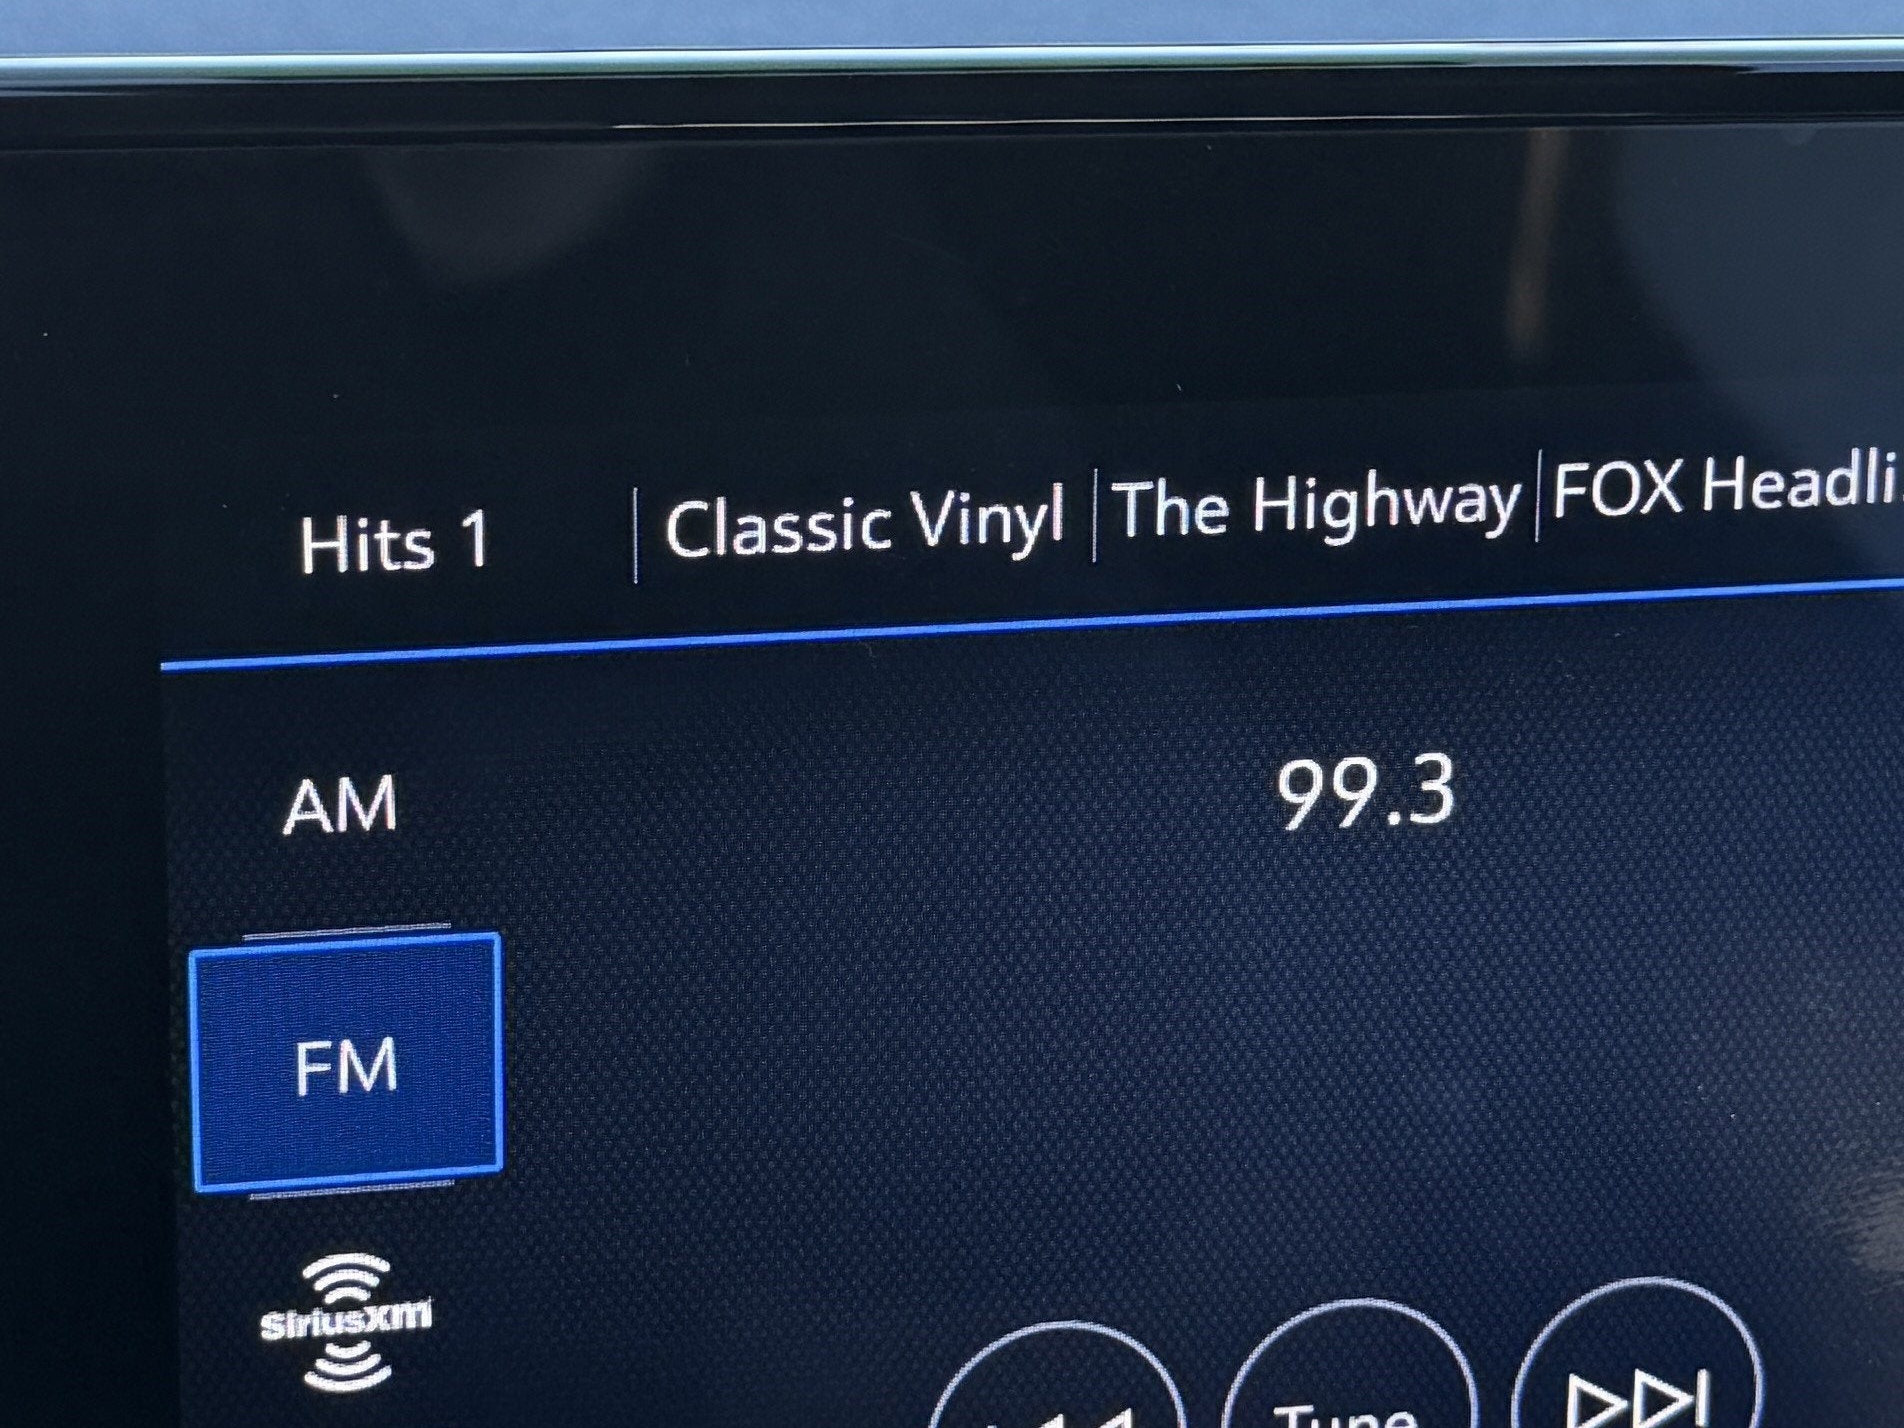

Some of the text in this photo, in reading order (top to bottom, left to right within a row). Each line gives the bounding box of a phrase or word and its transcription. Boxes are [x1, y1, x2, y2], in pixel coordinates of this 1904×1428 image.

[665, 480, 1066, 564] Classic Vinyl
[1109, 466, 1524, 549] The Highway
[1553, 457, 1686, 521] FOX
[301, 507, 487, 575] Hits 1
[280, 772, 399, 837] AM
[1276, 750, 1457, 833] 99.3
[295, 1034, 399, 1098] FM
